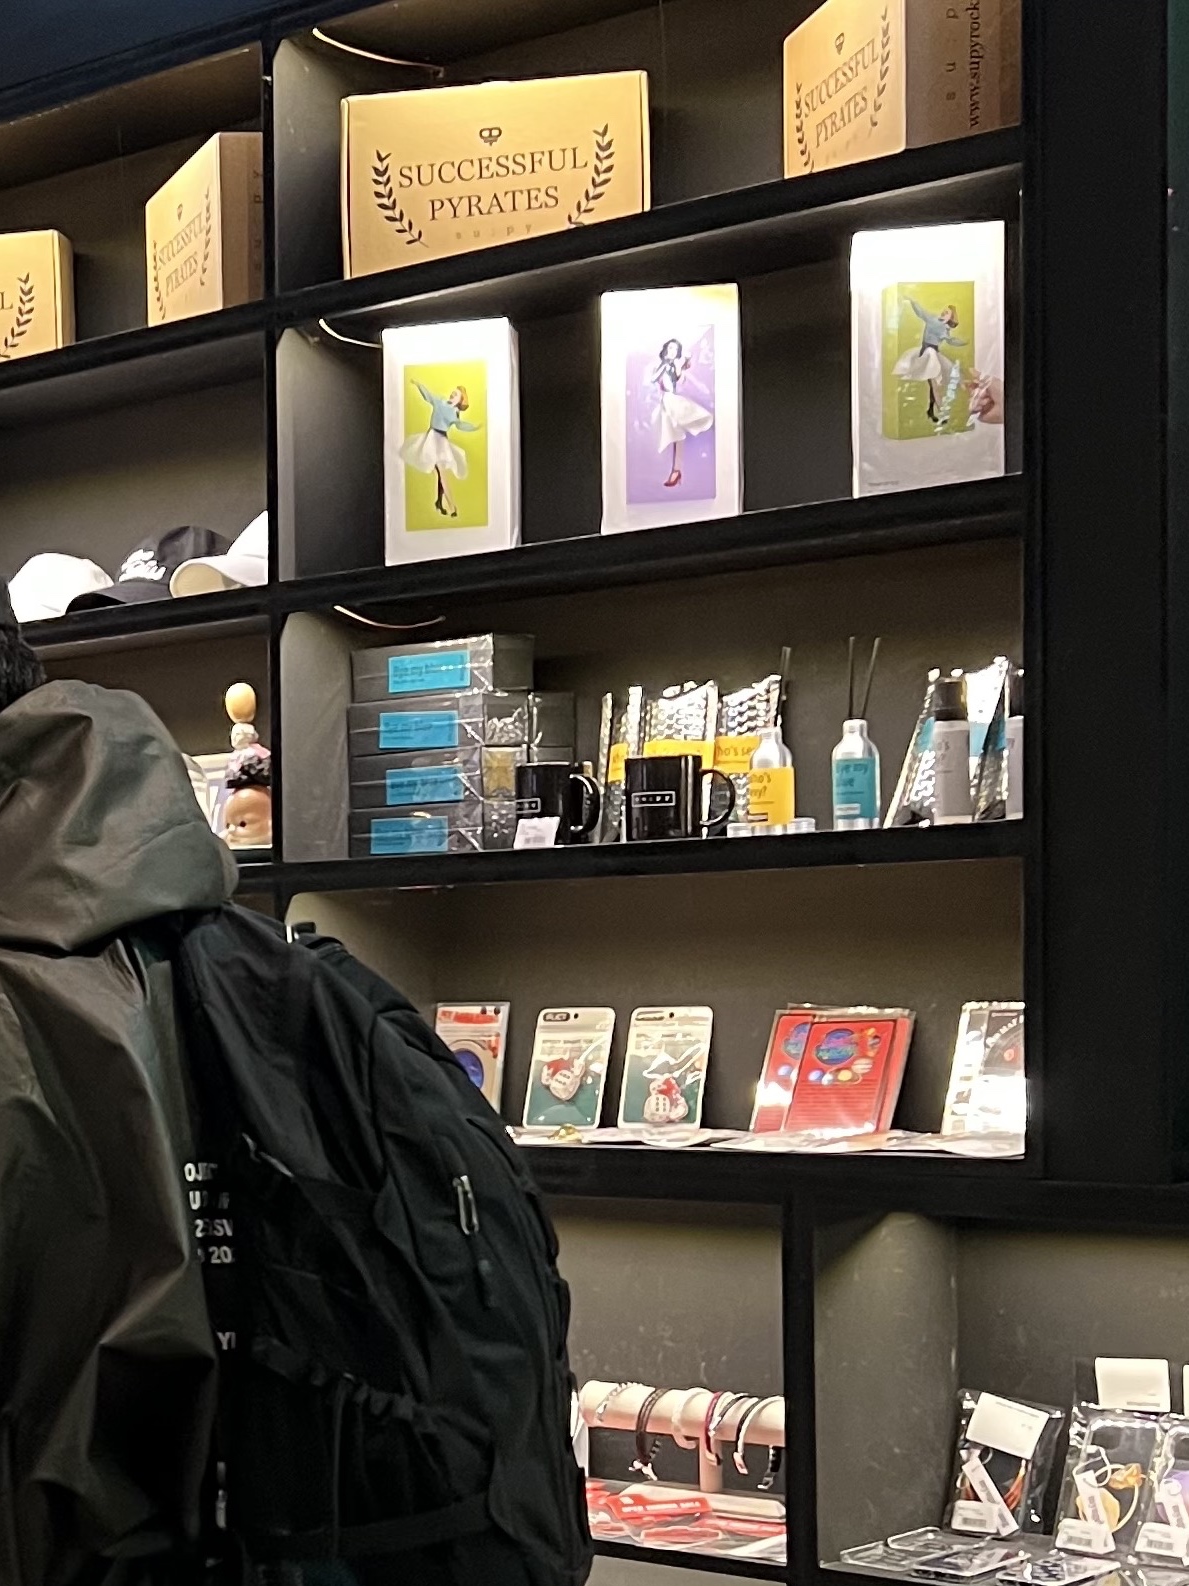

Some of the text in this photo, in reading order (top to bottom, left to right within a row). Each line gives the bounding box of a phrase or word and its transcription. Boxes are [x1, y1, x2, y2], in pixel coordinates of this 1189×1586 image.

[804, 38, 879, 118] SUCCESSFUL
[815, 85, 868, 149] PYRATES
[398, 147, 588, 188] SUCCESSFUL
[429, 185, 559, 221] PYRATES
